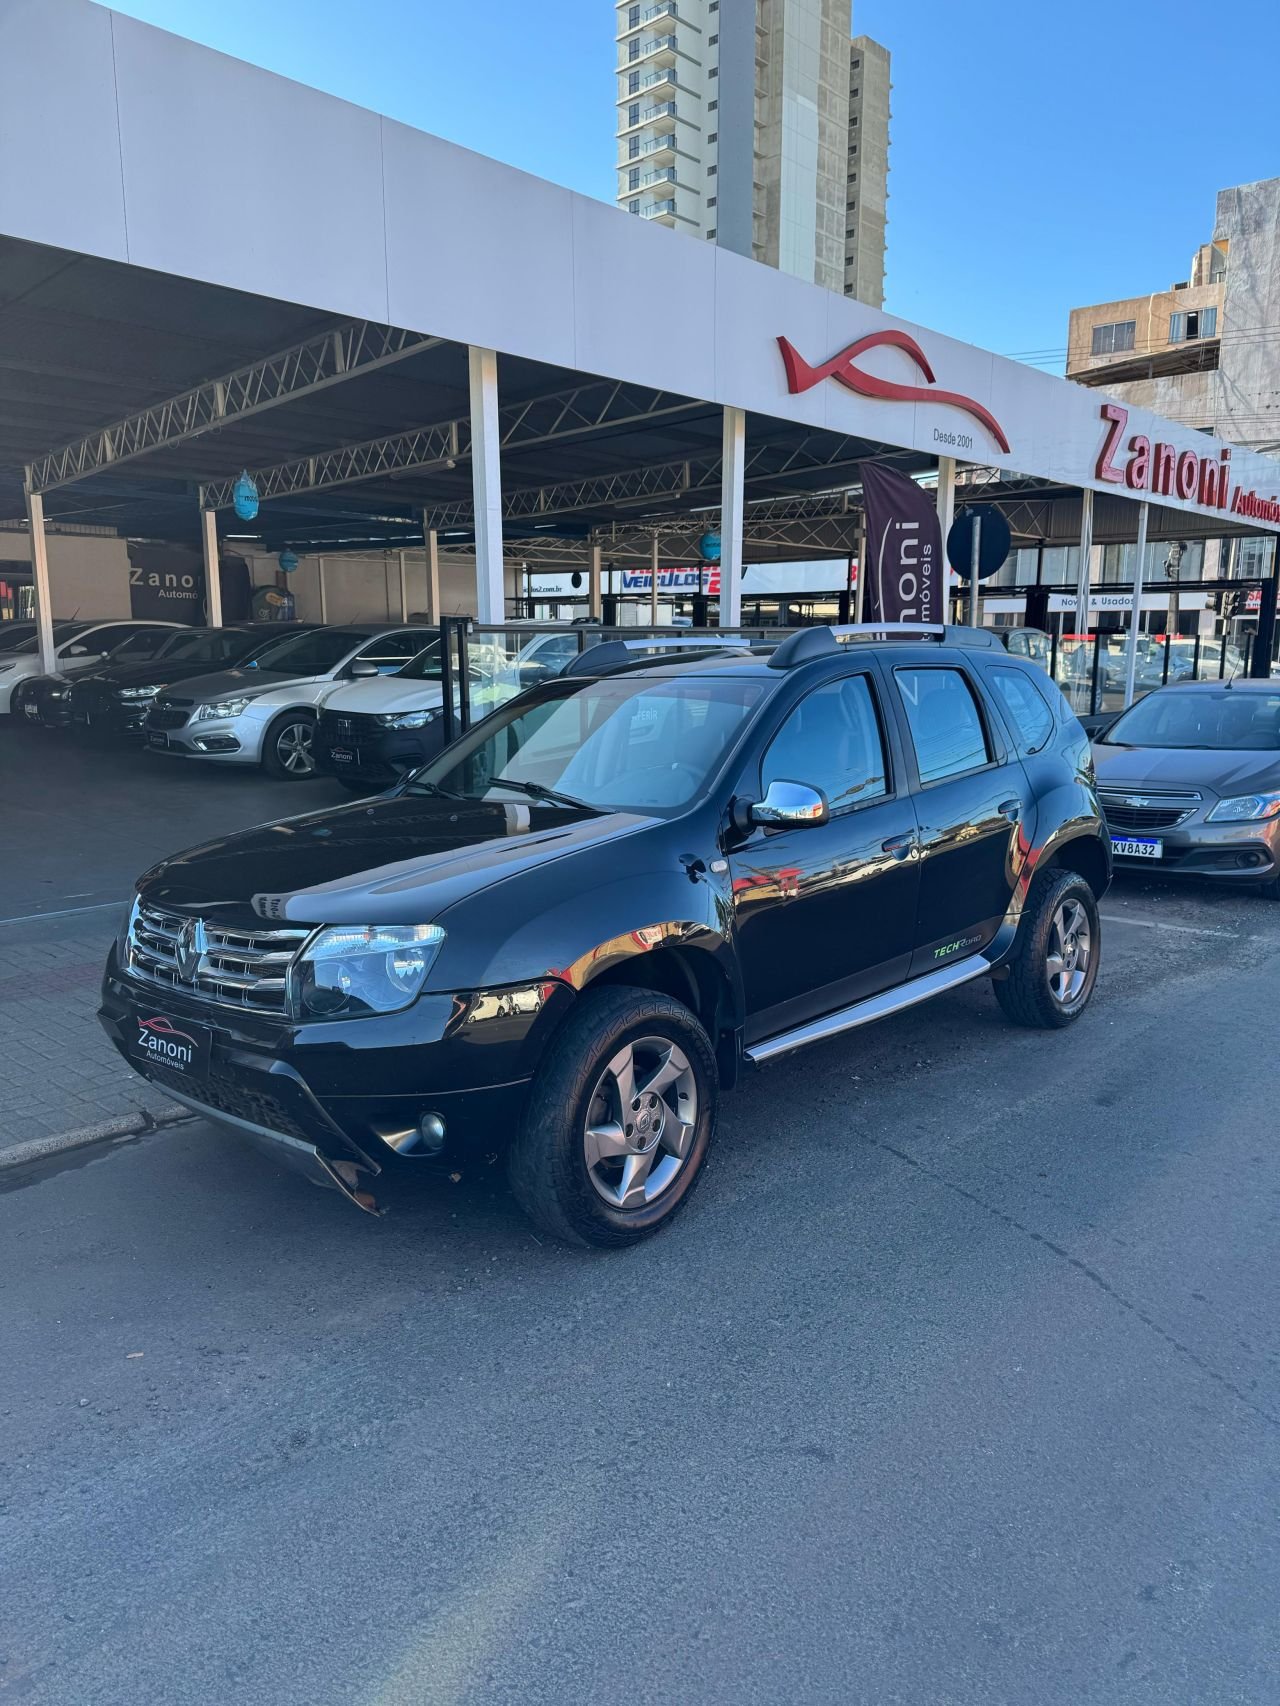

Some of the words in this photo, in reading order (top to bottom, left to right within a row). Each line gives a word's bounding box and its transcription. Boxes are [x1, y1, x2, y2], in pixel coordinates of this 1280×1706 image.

[933, 428, 956, 446] Desde
[957, 434, 973, 449] 2001
[1095, 403, 1231, 509] Zanoni
[128, 567, 199, 589] Zano
[1061, 598, 1078, 607] Nov
[1091, 598, 1097, 606] &
[1101, 597, 1134, 606] Usados
[1112, 841, 1155, 856] KV8A32
[138, 1027, 192, 1063] Zanoni
[146, 1050, 185, 1071] Automóveis
